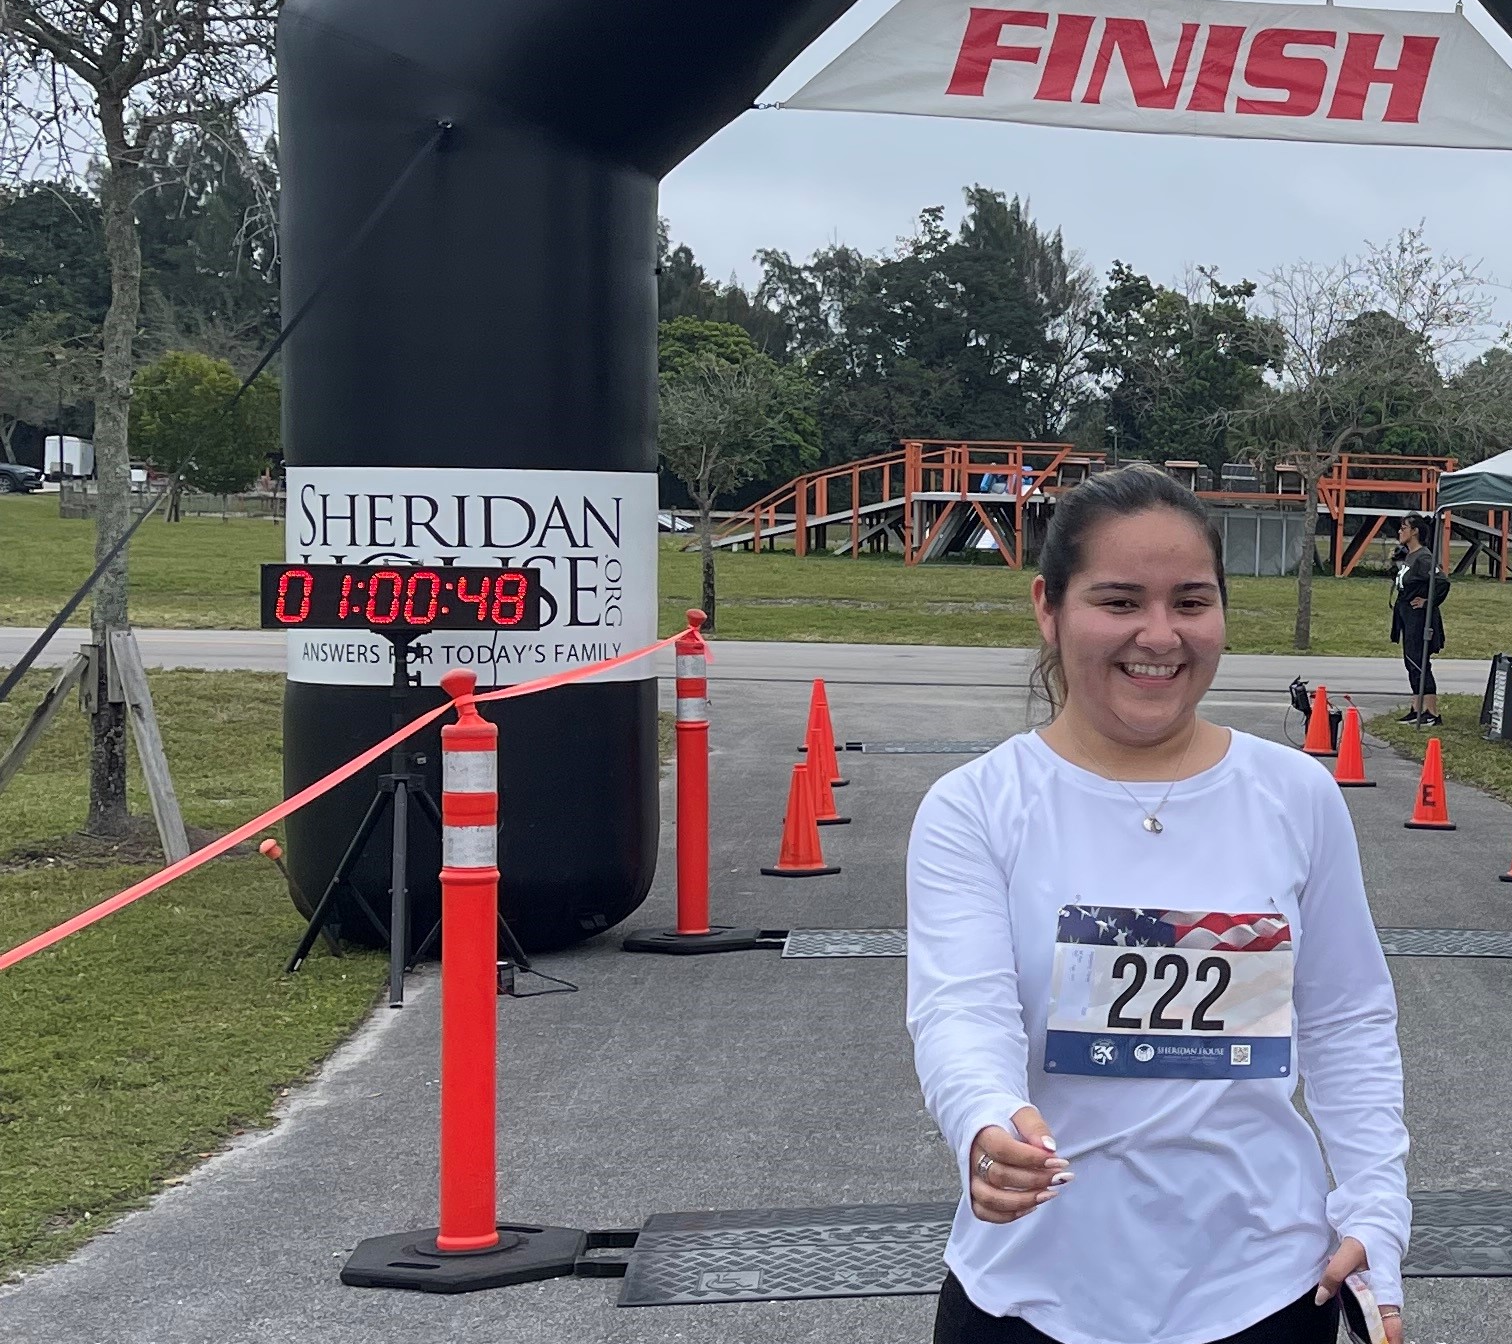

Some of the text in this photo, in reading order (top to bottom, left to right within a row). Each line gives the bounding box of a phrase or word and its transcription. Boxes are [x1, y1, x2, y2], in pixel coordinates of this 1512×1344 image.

[945, 7, 1440, 123] FINISH
[300, 483, 623, 549] SHERIDAN
[275, 569, 528, 625] 01:00:48
[302, 642, 380, 663] ANSWERS
[440, 642, 546, 665] TODAY'S
[554, 641, 623, 663] FAMILY
[1107, 952, 1232, 1031] 222
